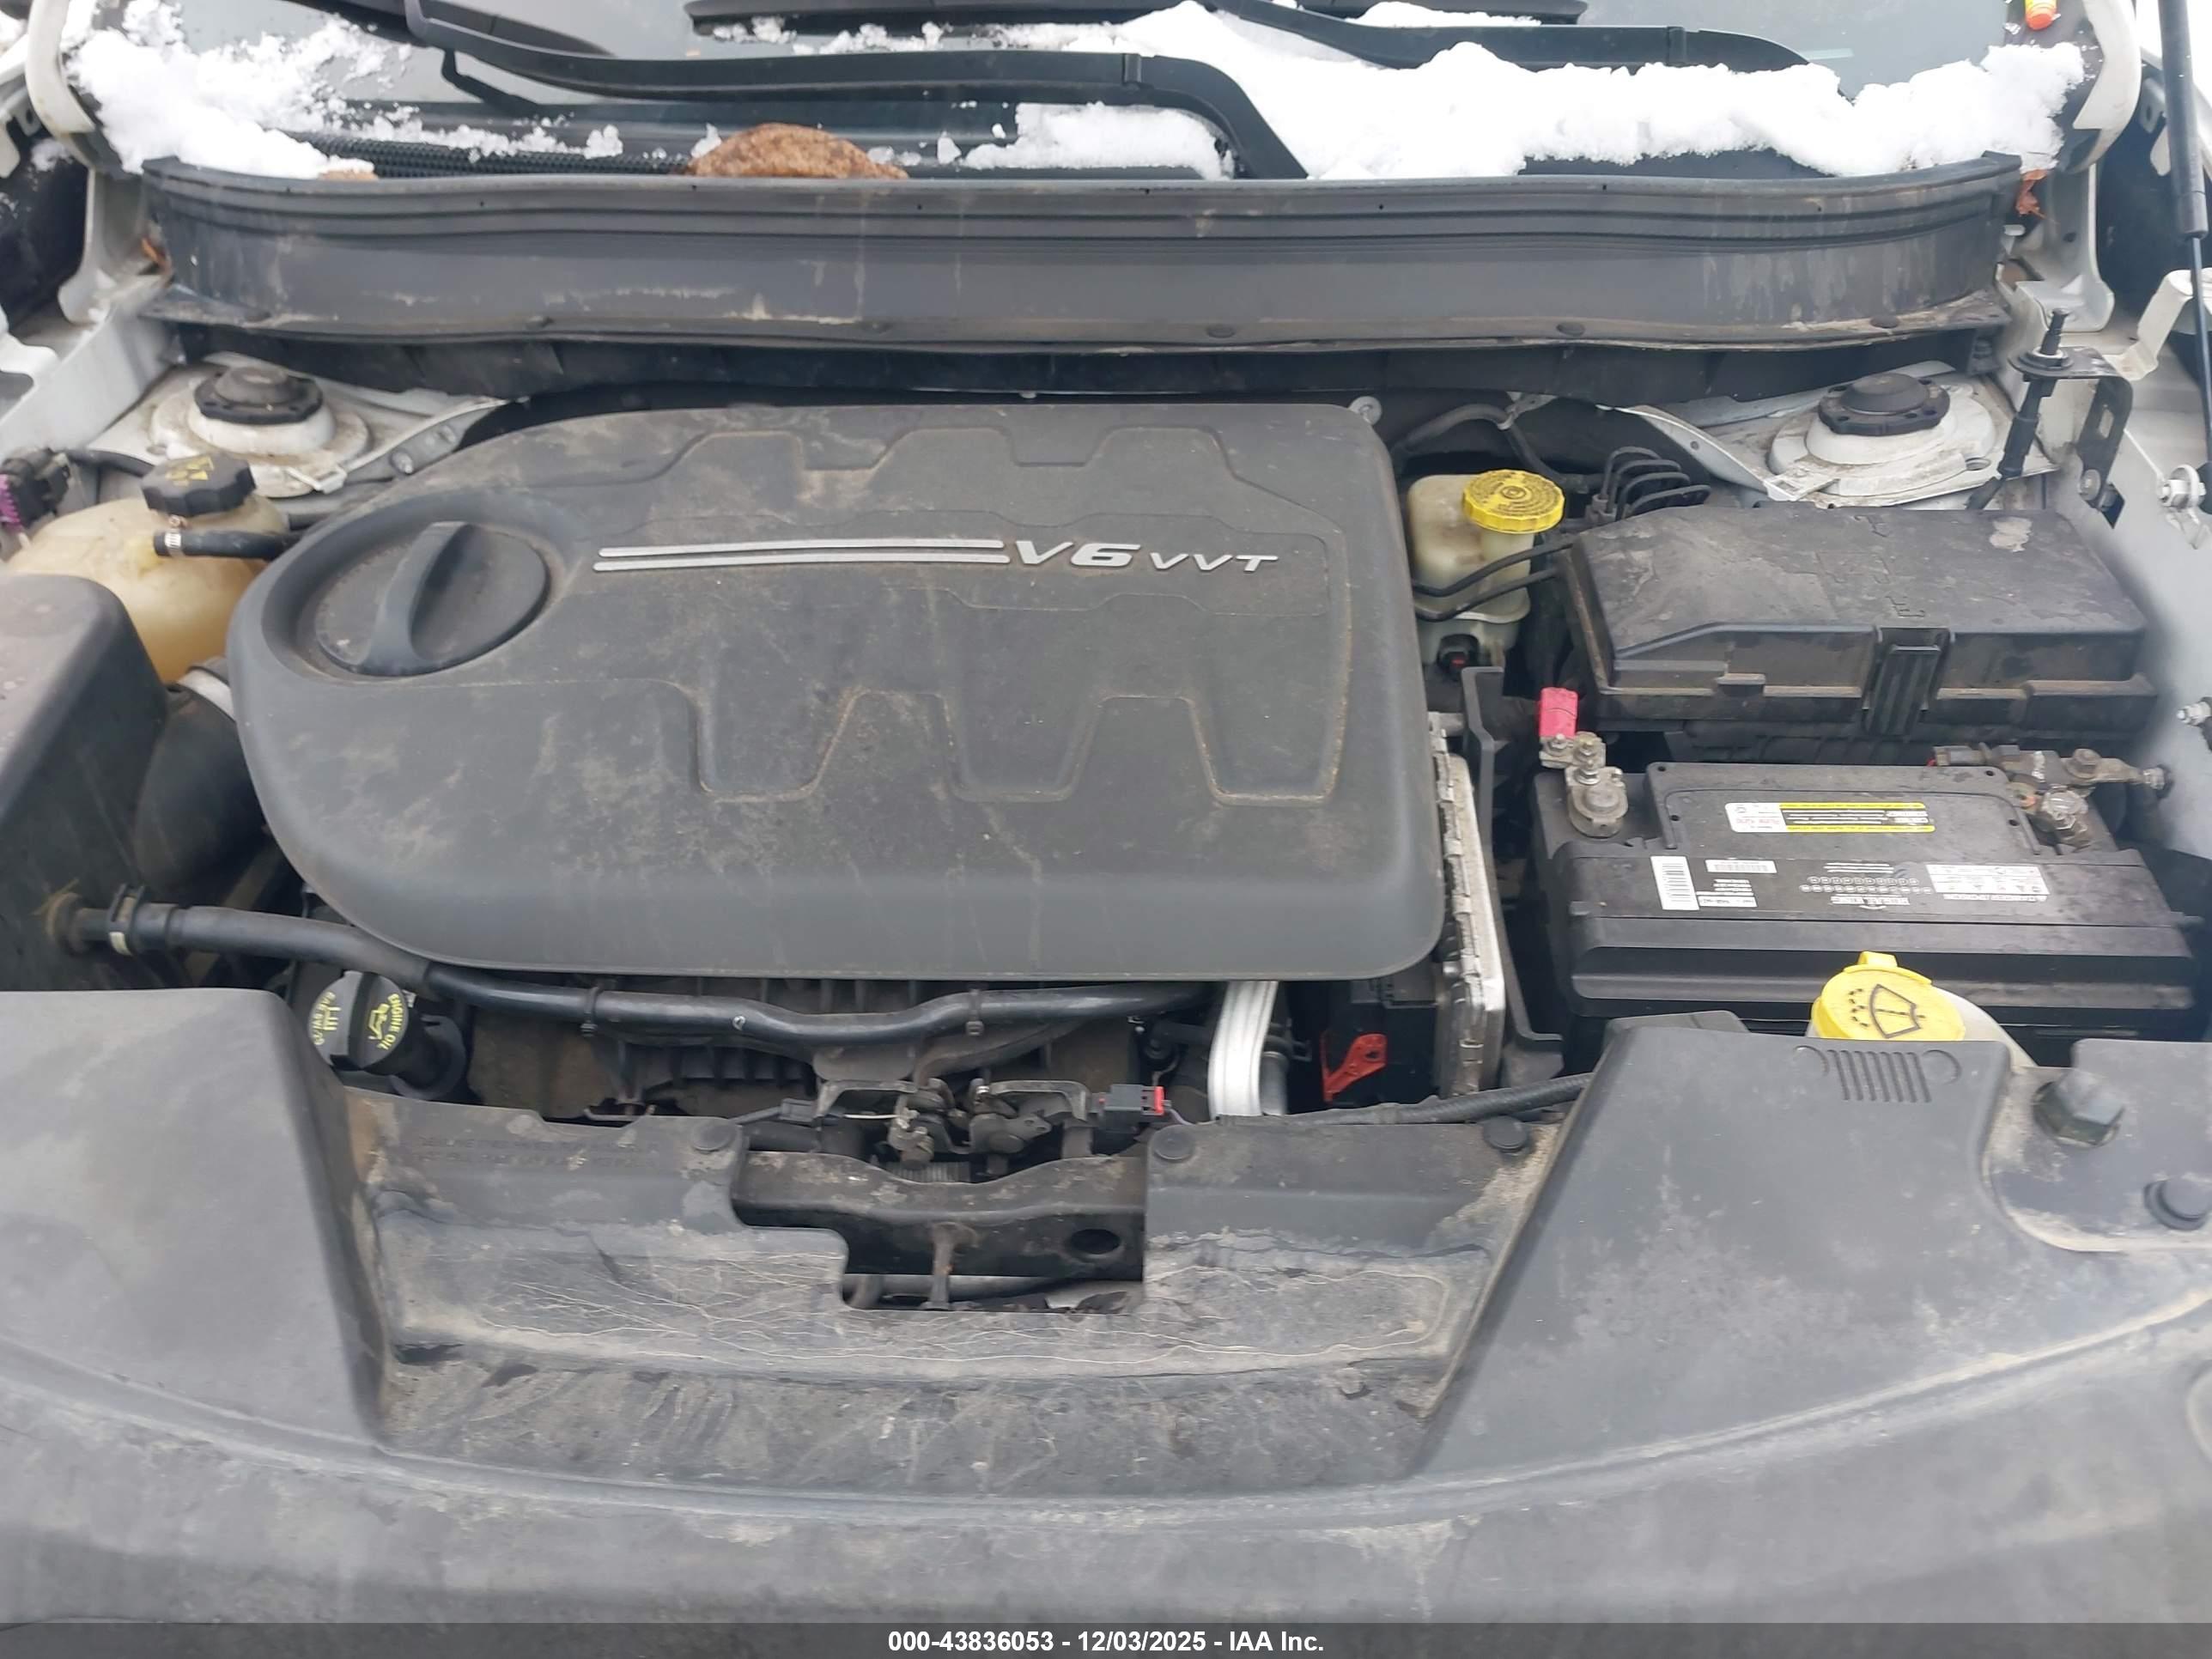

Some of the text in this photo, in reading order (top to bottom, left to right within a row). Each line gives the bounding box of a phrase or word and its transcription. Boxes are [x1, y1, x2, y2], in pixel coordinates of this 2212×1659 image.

[1016, 540, 1279, 572] V6 VVT
[377, 993, 404, 1050] ENGINE OIL
